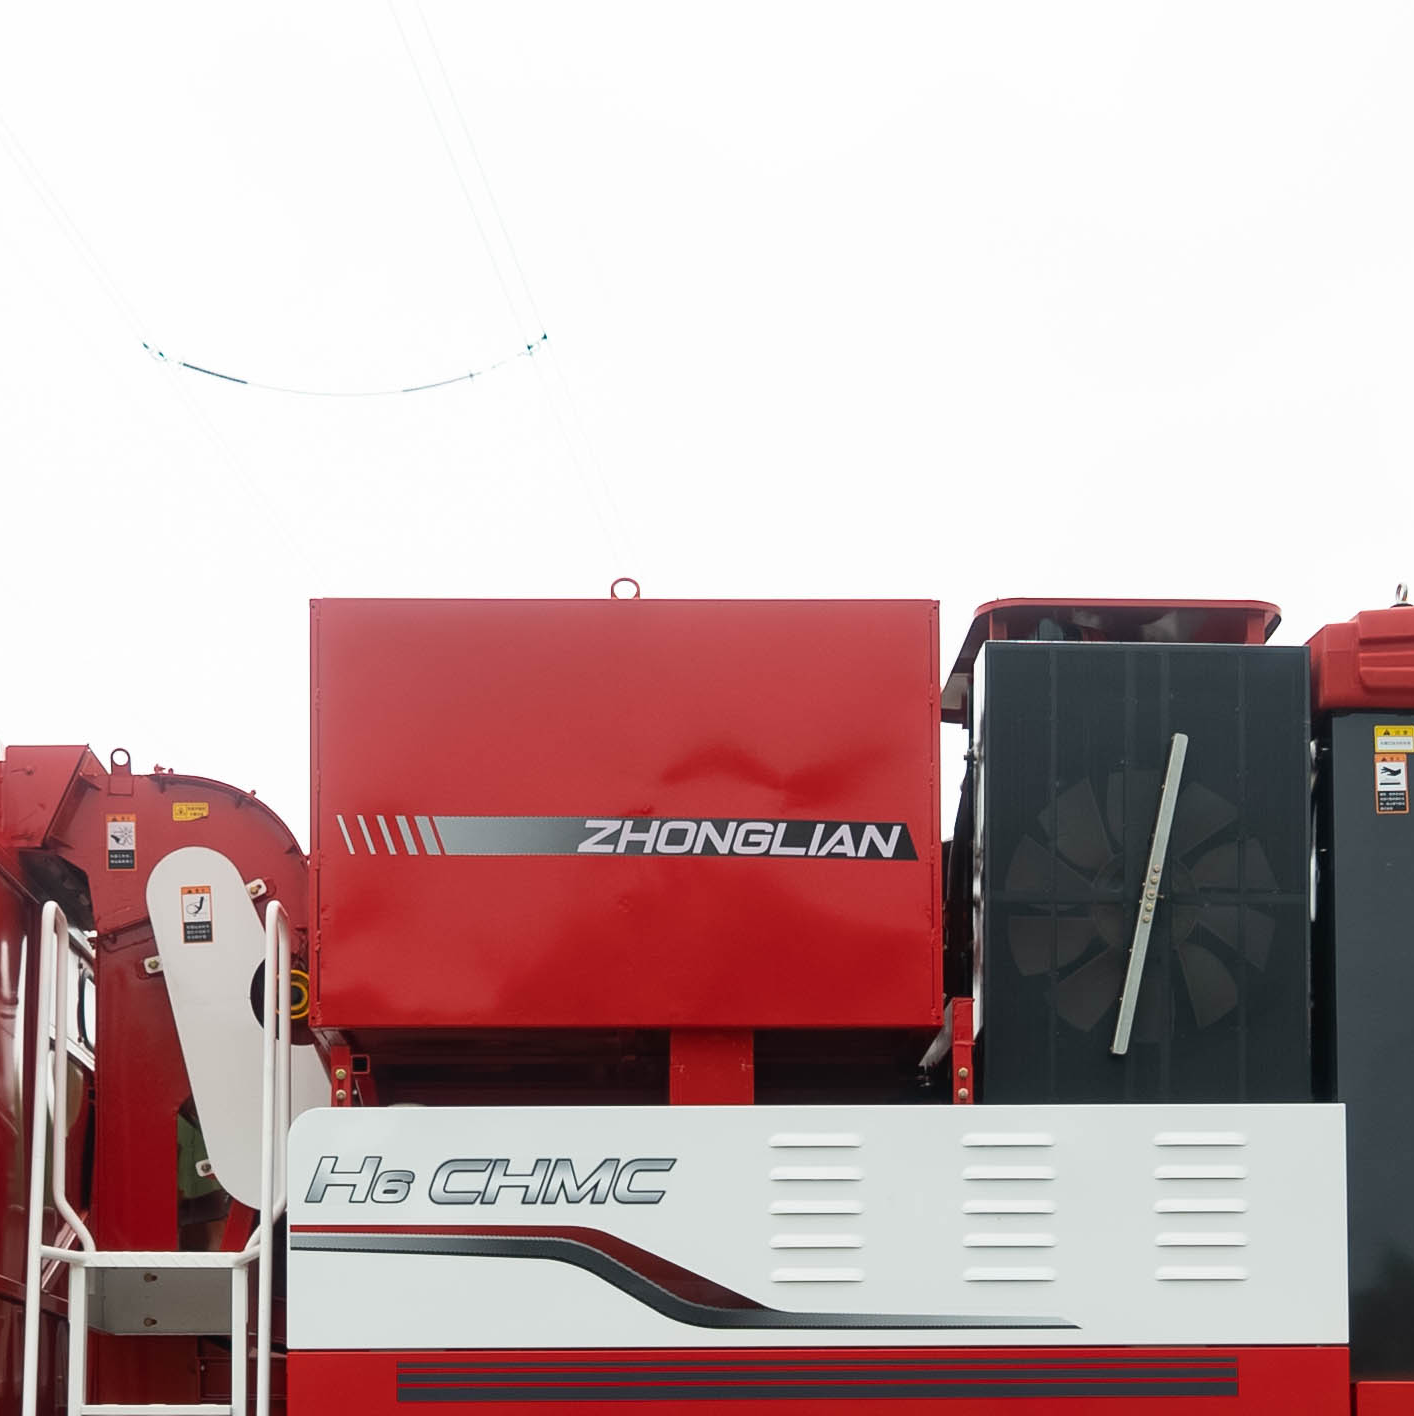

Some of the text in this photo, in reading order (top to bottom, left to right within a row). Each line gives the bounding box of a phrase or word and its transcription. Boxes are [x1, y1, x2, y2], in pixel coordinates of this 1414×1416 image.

[577, 819, 902, 858] ZHONGLIAN
[304, 1156, 677, 1205] H6 CHMC
